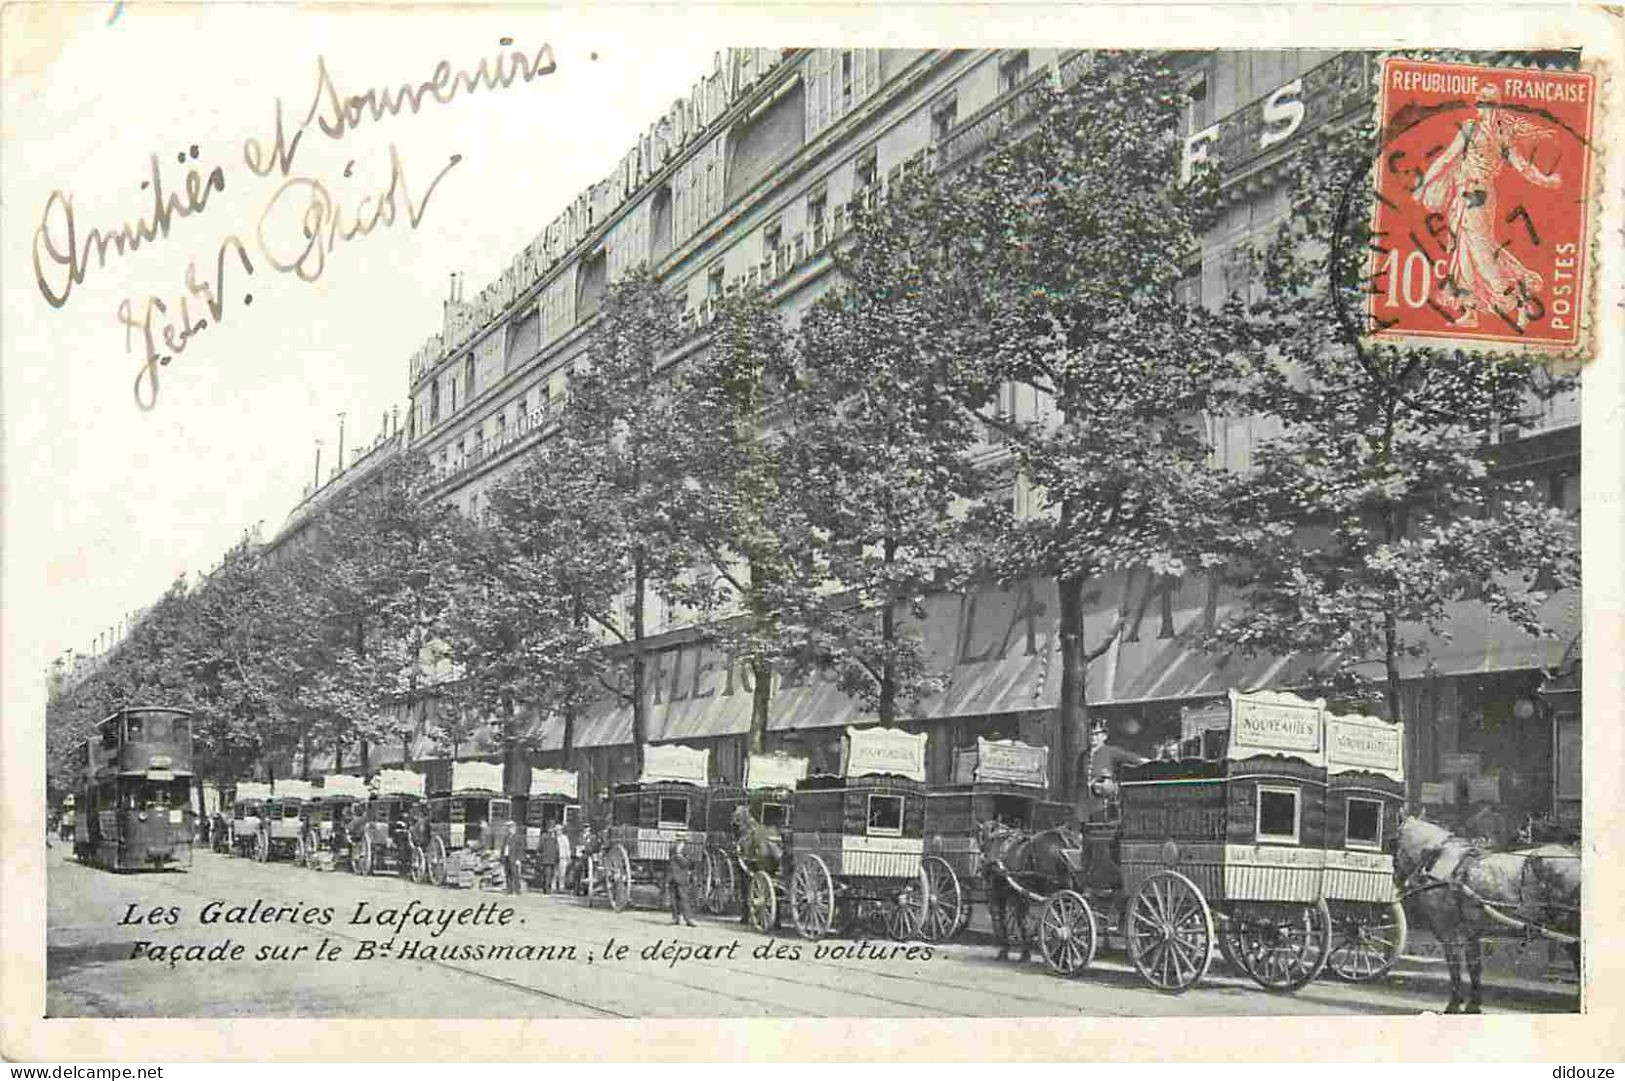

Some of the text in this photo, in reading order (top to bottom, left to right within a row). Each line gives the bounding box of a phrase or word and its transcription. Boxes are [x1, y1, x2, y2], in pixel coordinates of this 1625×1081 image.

[1504, 78, 1587, 102] FRANÇAISE
[244, 98, 302, 178] et
[1551, 243, 1576, 330] POSTES
